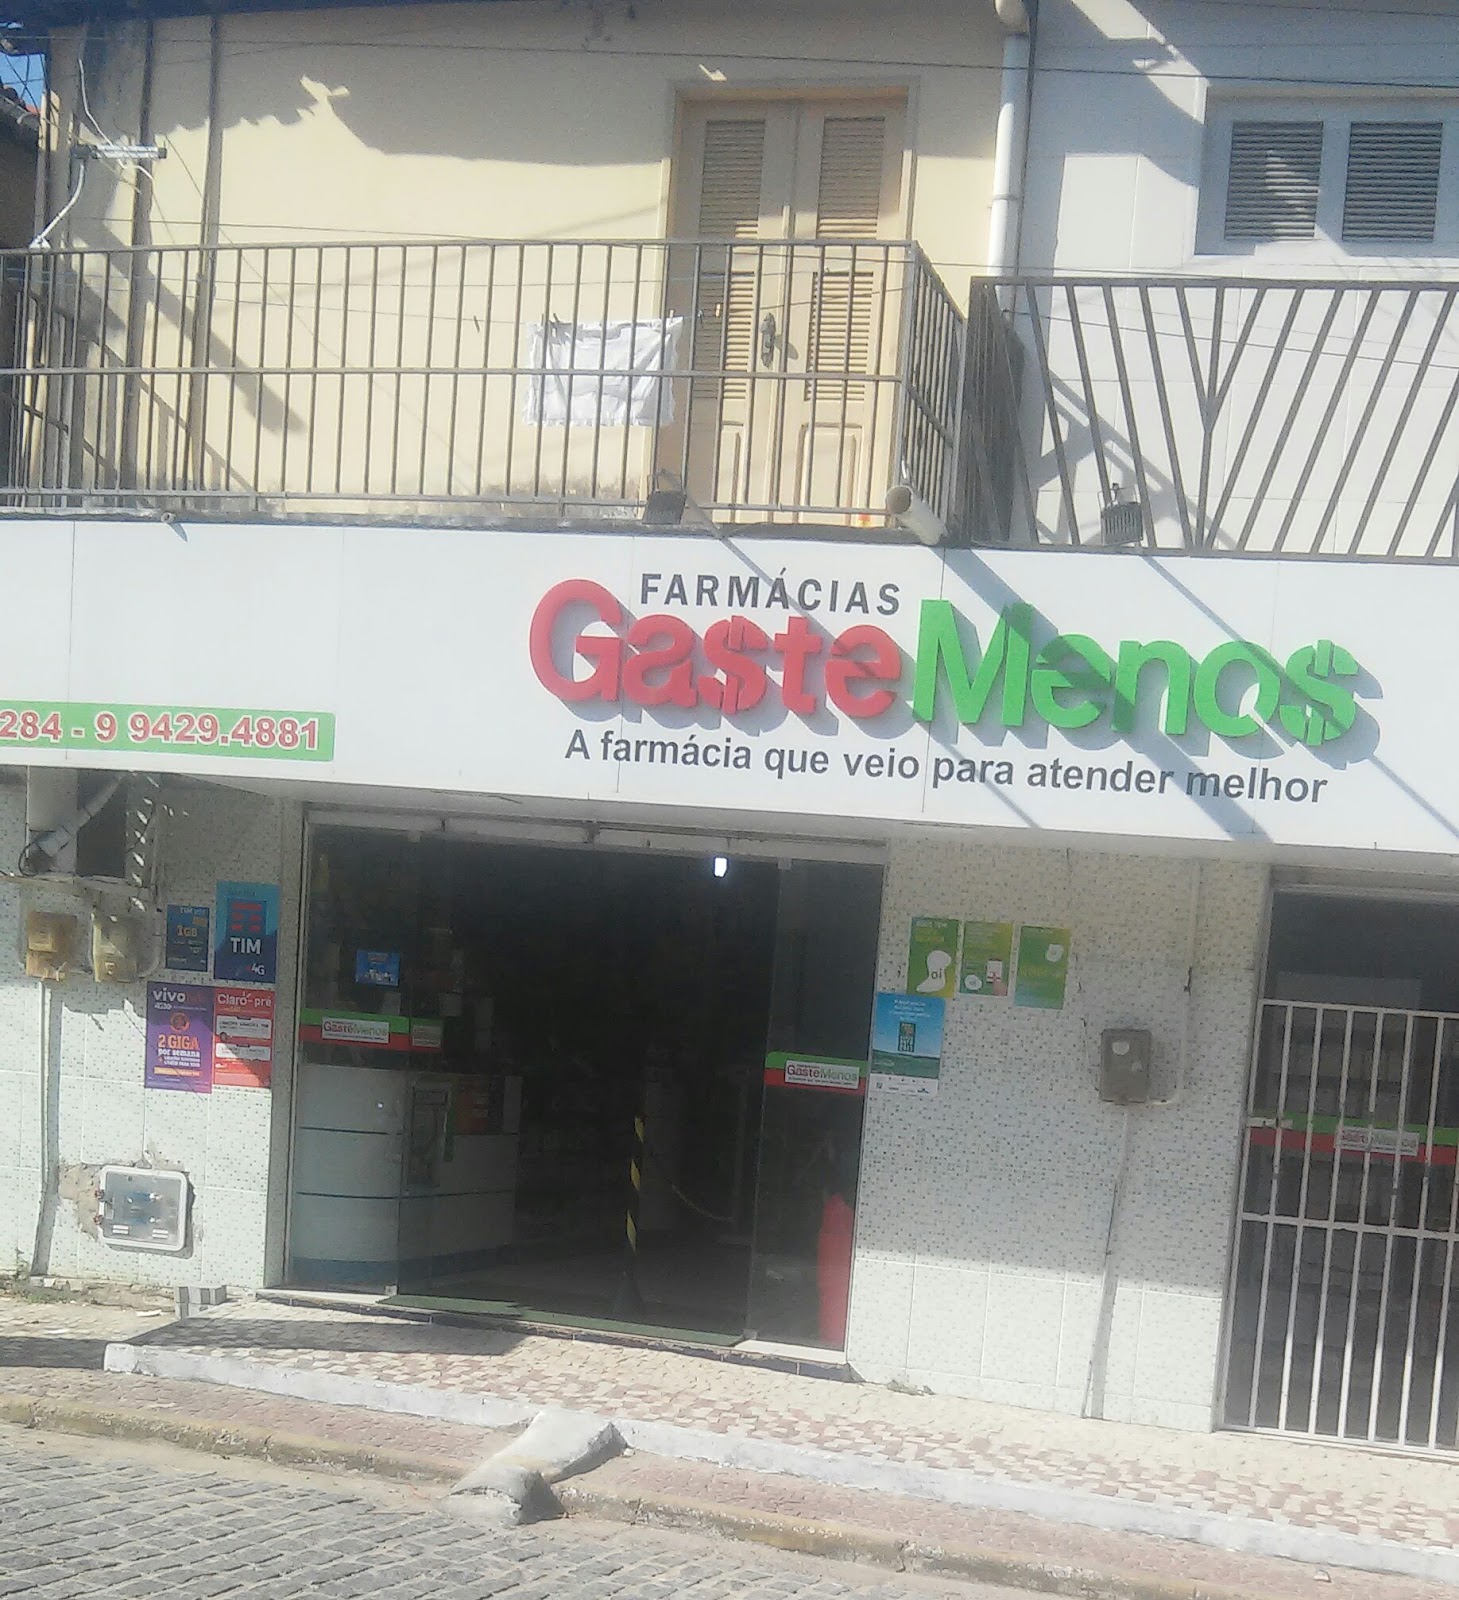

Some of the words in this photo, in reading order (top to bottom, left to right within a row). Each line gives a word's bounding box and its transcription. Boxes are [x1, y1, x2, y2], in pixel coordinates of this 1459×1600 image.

[640, 567, 901, 616] FARMÁCIAS
[95, 711, 118, 742] 9
[129, 713, 320, 749] 9429.4881
[564, 728, 591, 761] A
[601, 730, 752, 770] farmácia
[764, 746, 830, 779] que
[844, 746, 920, 779] veio
[932, 755, 1014, 788] para
[1026, 761, 1175, 796] atender
[1185, 767, 1328, 803] melhor
[230, 937, 261, 955] TIM
[251, 962, 266, 976] 4G
[931, 968, 942, 980] oi
[153, 986, 186, 1003] vivo
[168, 1034, 199, 1050] GIGA
[172, 1049, 201, 1058] semana
